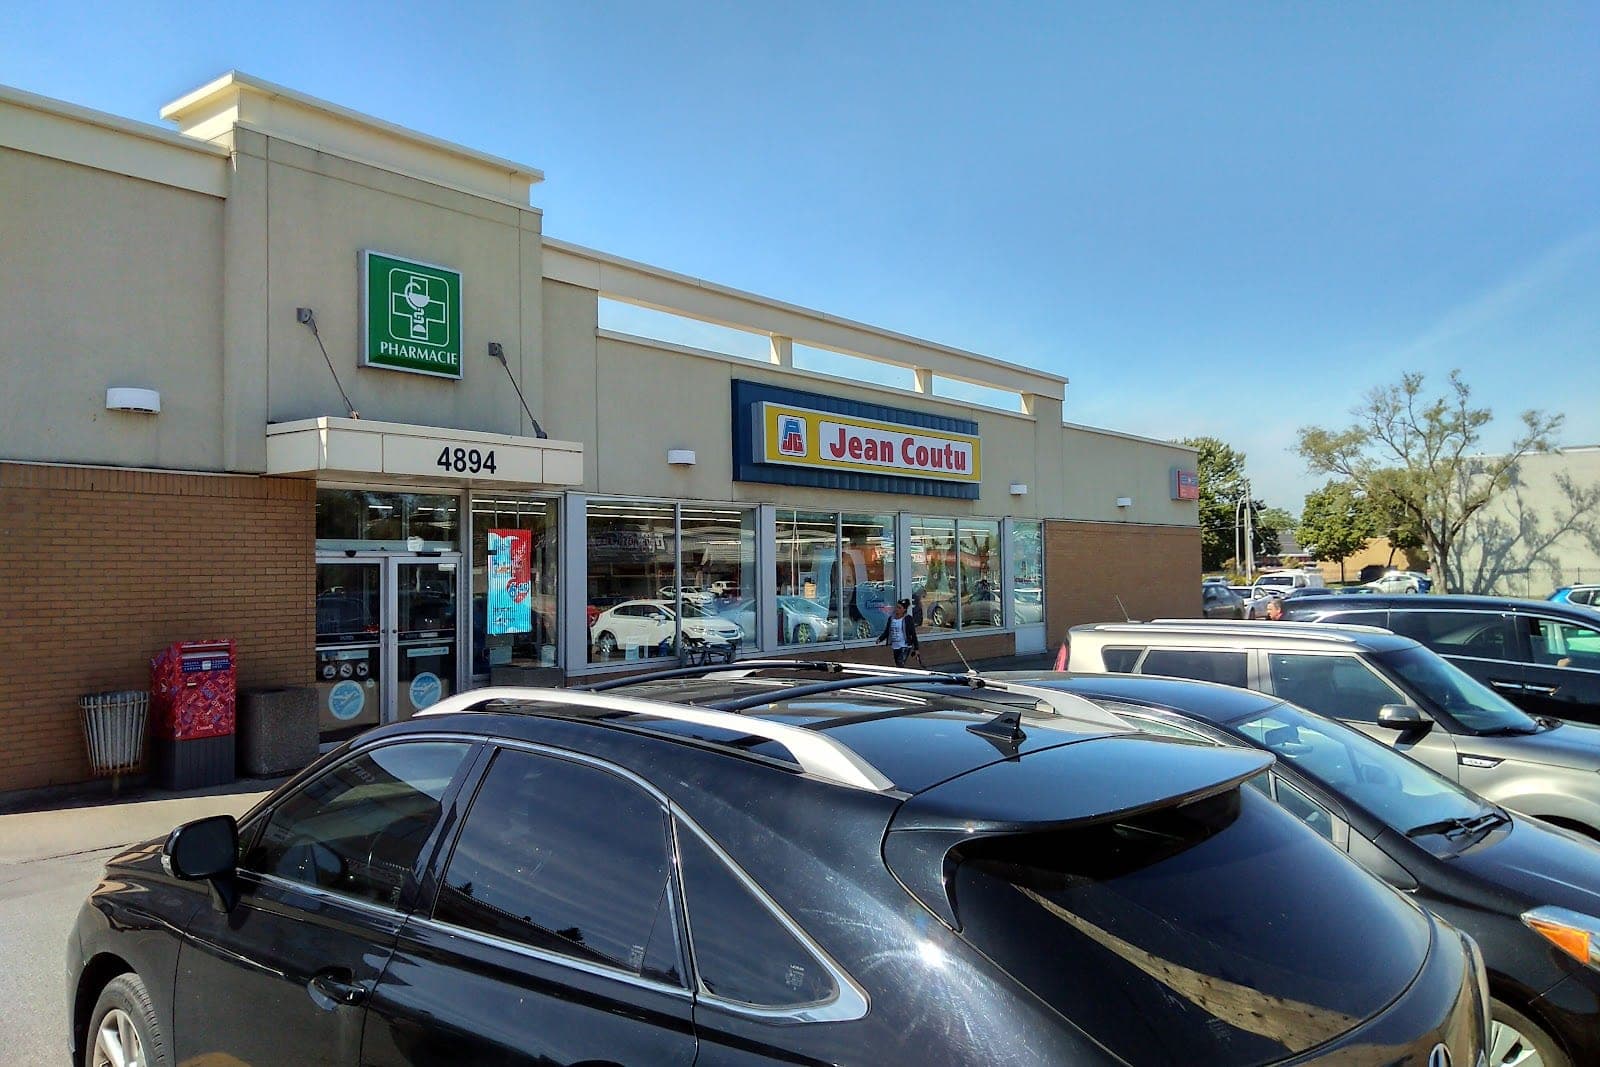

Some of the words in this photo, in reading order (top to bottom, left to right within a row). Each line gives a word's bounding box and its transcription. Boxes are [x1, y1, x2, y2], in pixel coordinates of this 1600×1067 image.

[380, 341, 458, 365] PHARMACIE
[436, 446, 497, 475] 4894
[829, 427, 894, 463] Jean
[901, 437, 966, 471] Coutu
